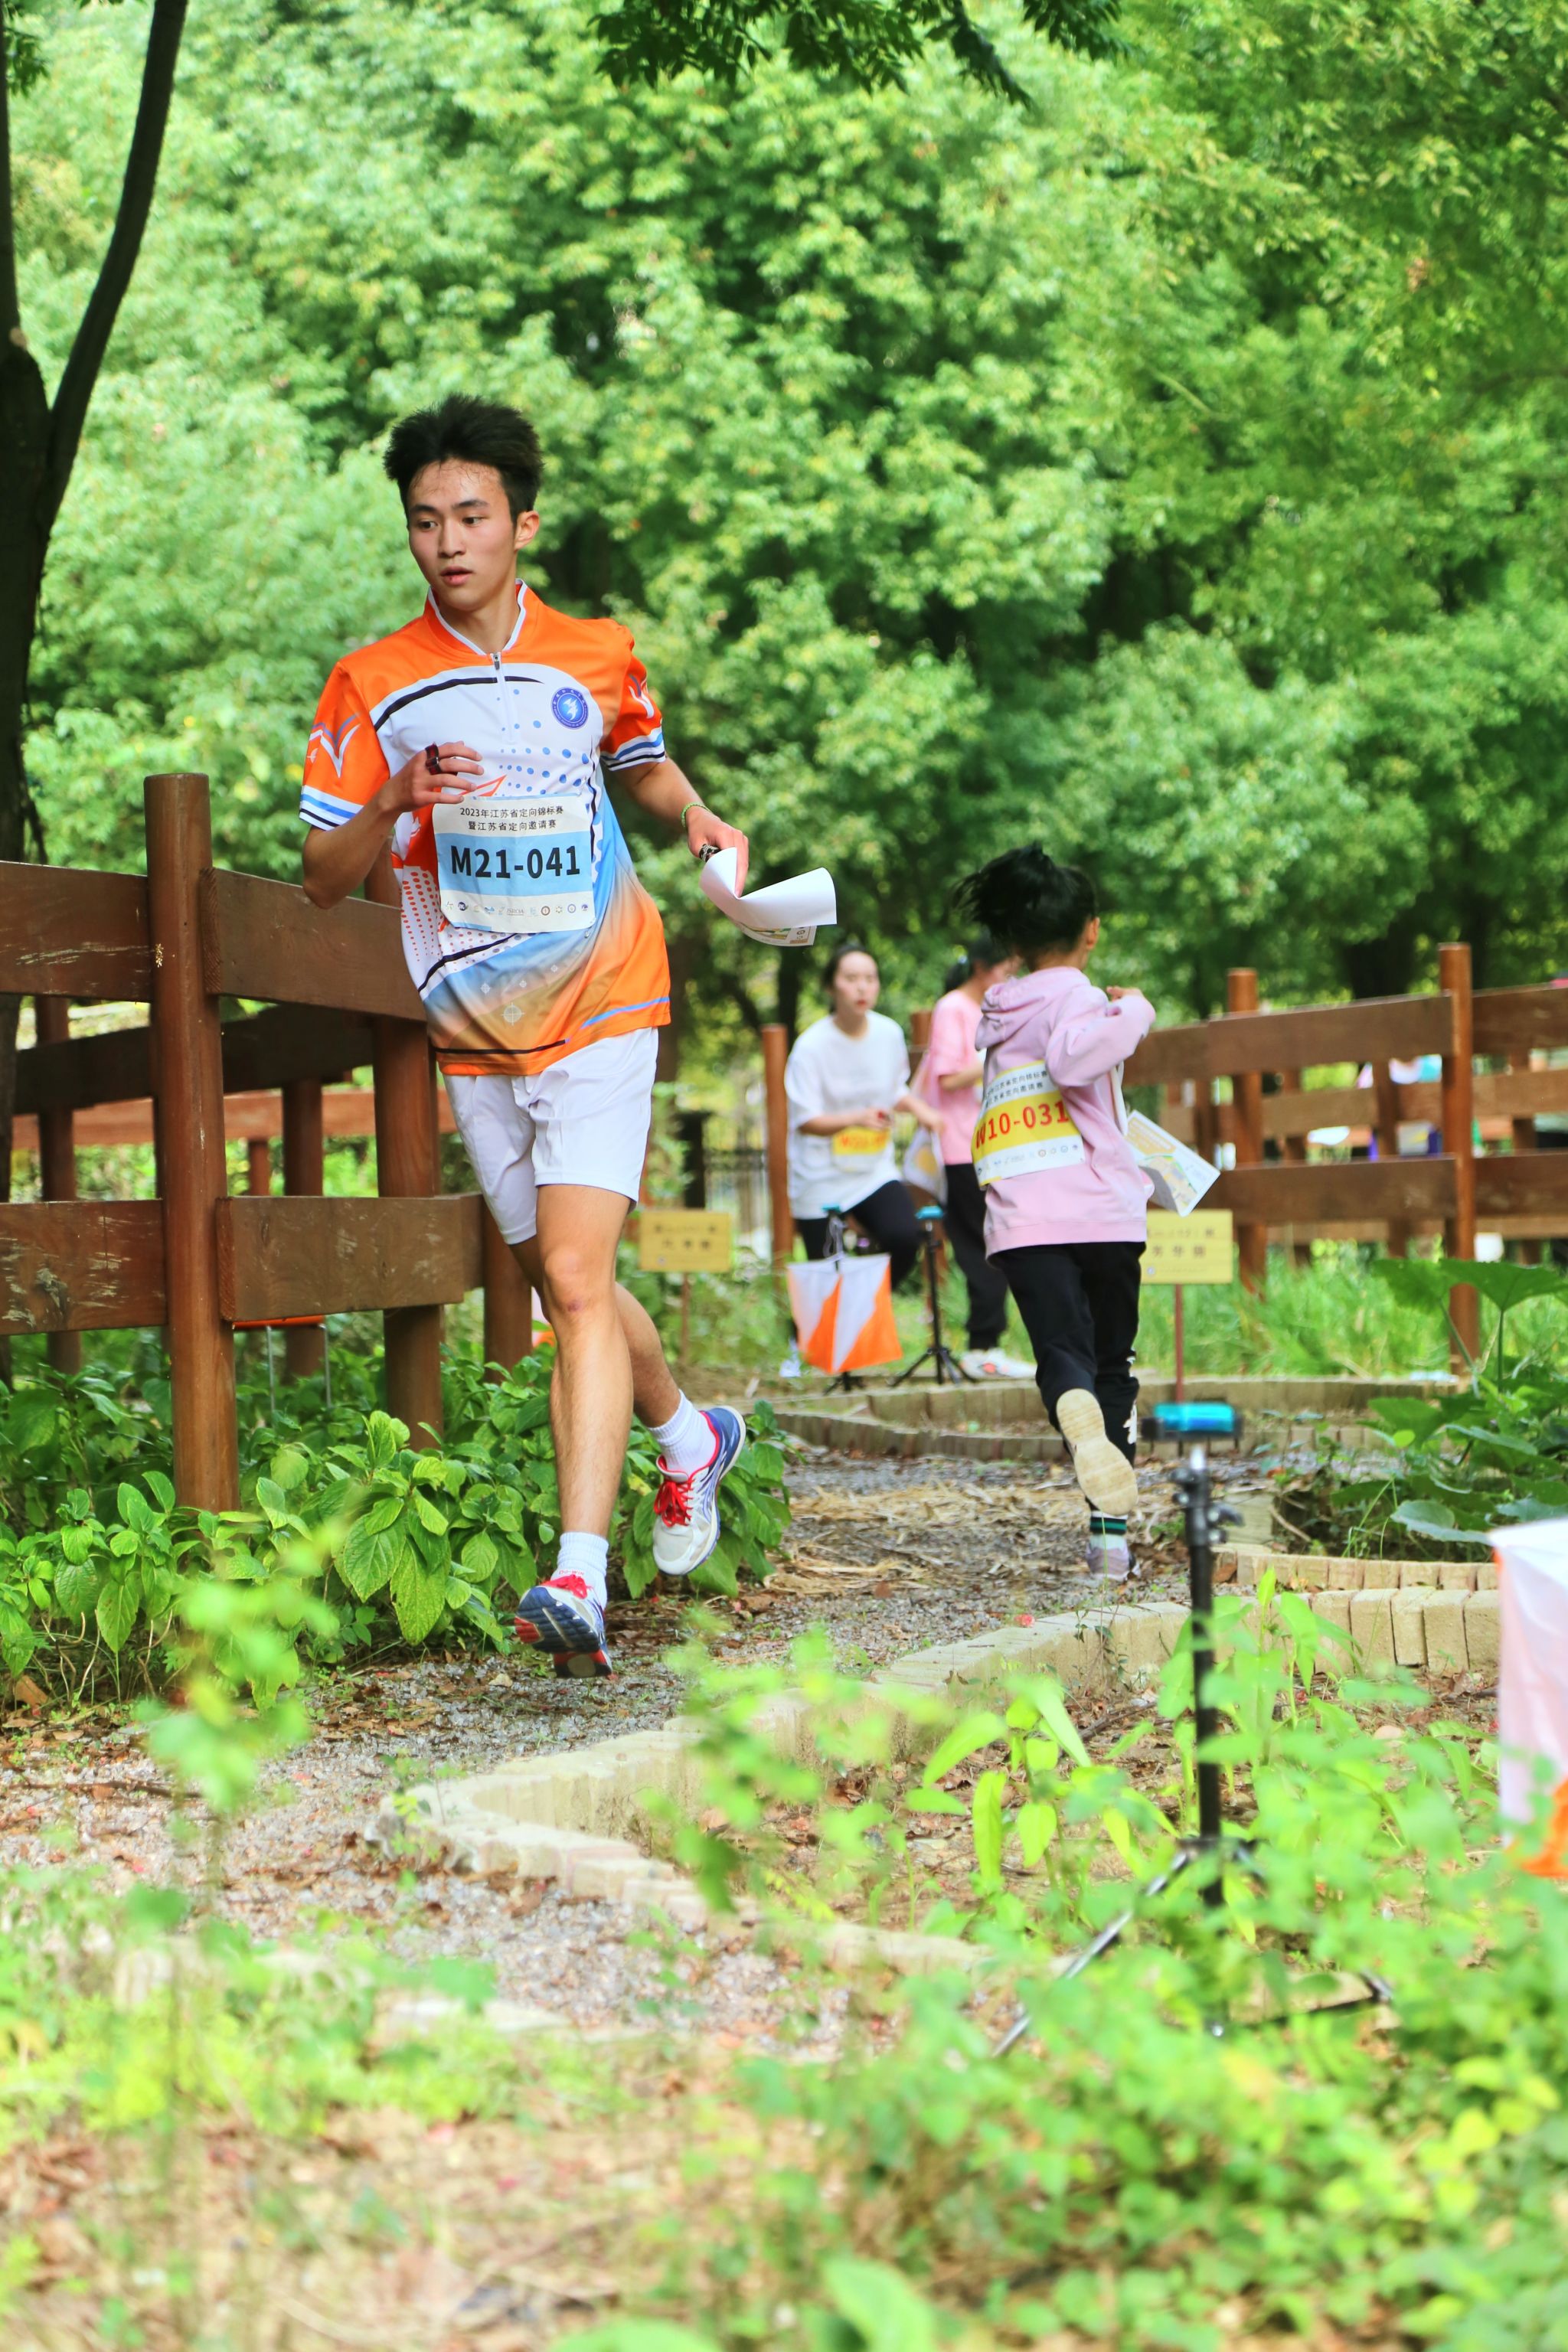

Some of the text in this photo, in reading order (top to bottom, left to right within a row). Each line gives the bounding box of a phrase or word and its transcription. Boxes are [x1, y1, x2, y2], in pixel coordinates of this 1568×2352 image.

[459, 805, 564, 818] 2023年江苏省定向锦标赛
[468, 819, 557, 831] 暨江苏省定向邀请赛
[450, 845, 580, 879] M21-041
[975, 1099, 1070, 1149] W10-031
